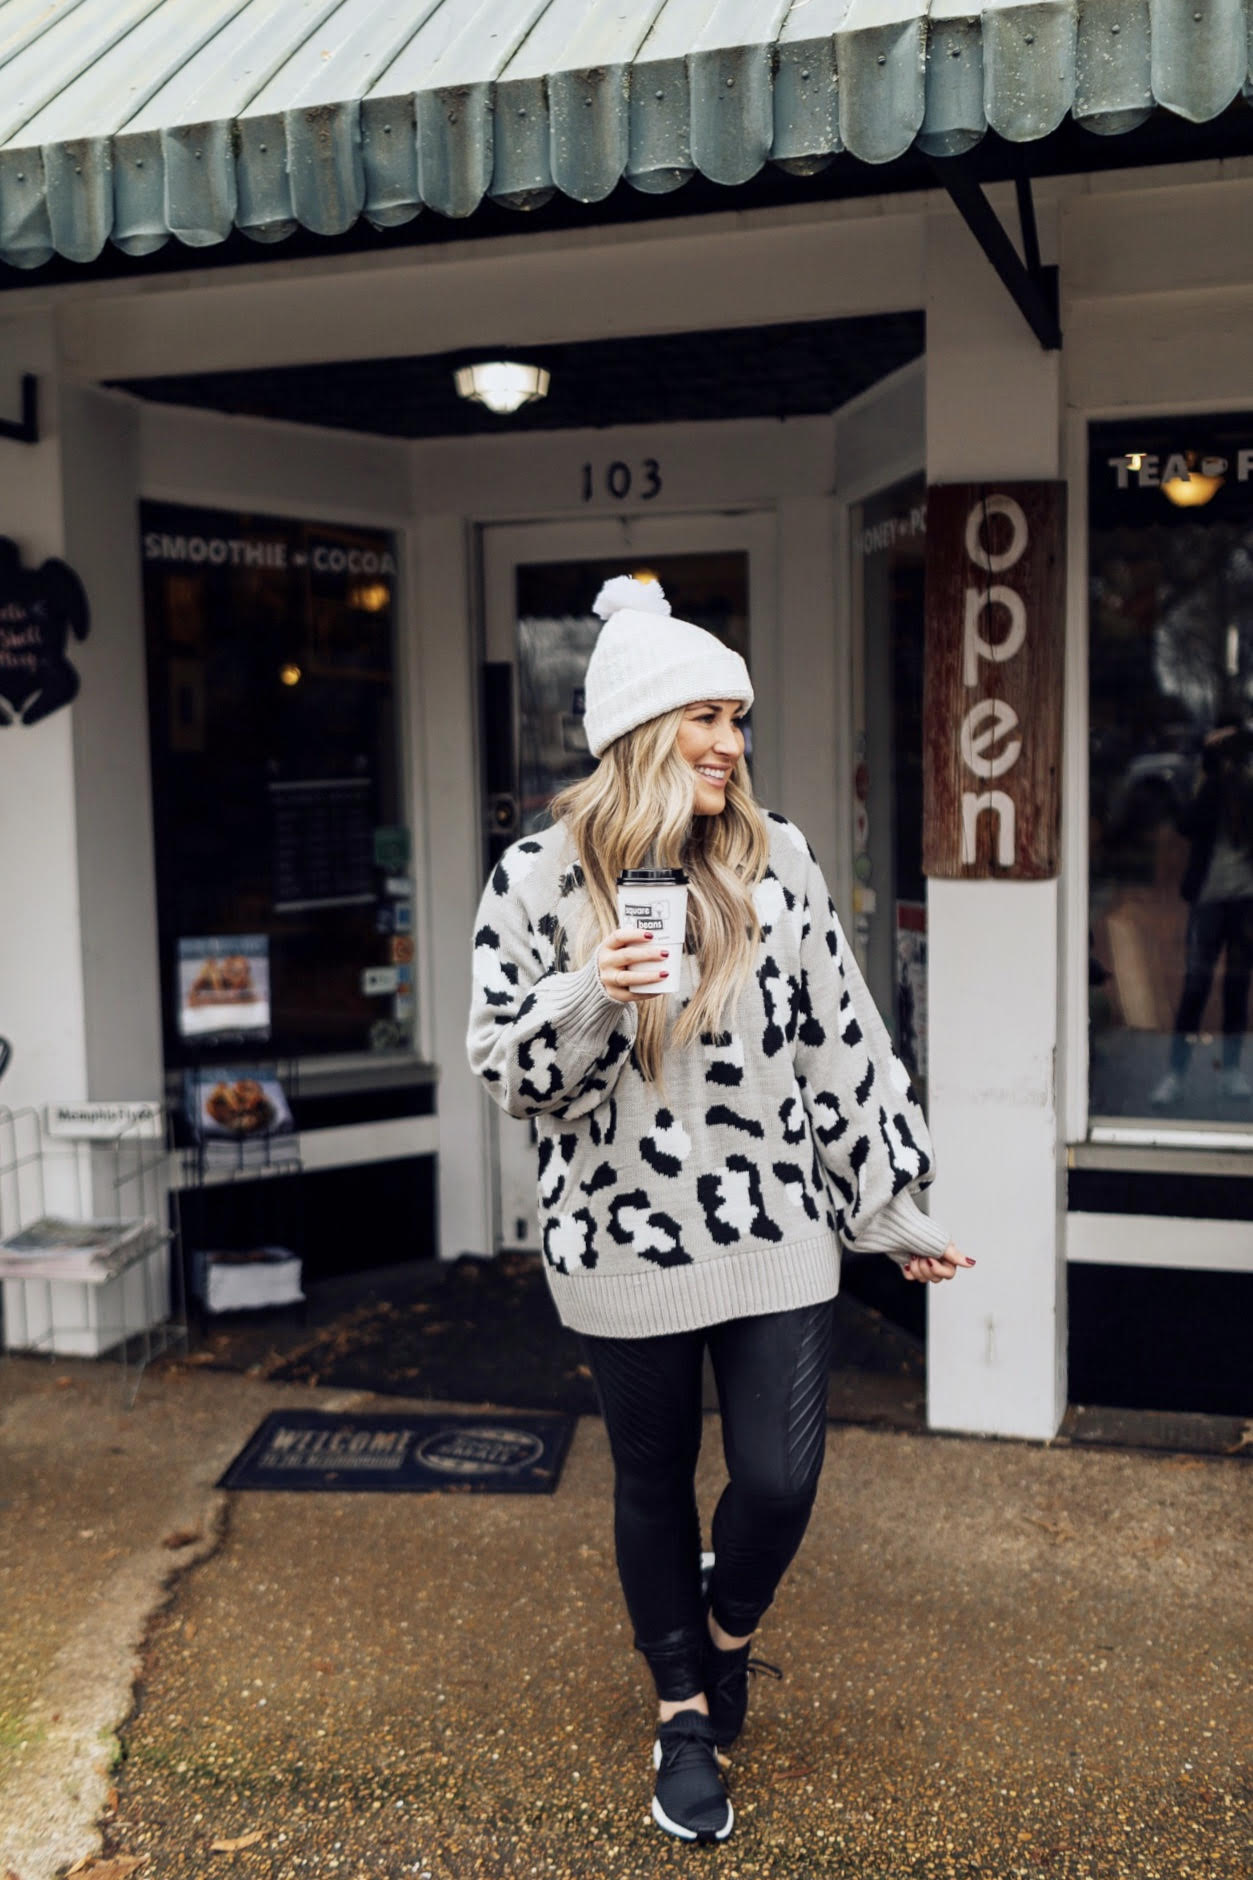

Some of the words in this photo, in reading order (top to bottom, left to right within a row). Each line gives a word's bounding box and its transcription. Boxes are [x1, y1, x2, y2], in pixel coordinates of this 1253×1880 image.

[581, 458, 662, 502] 103
[1108, 453, 1190, 488] TEA
[145, 532, 288, 569] SMOOTHIE
[312, 546, 398, 576] COCOA
[960, 493, 1029, 868] open
[272, 1427, 416, 1452] WELCOME
